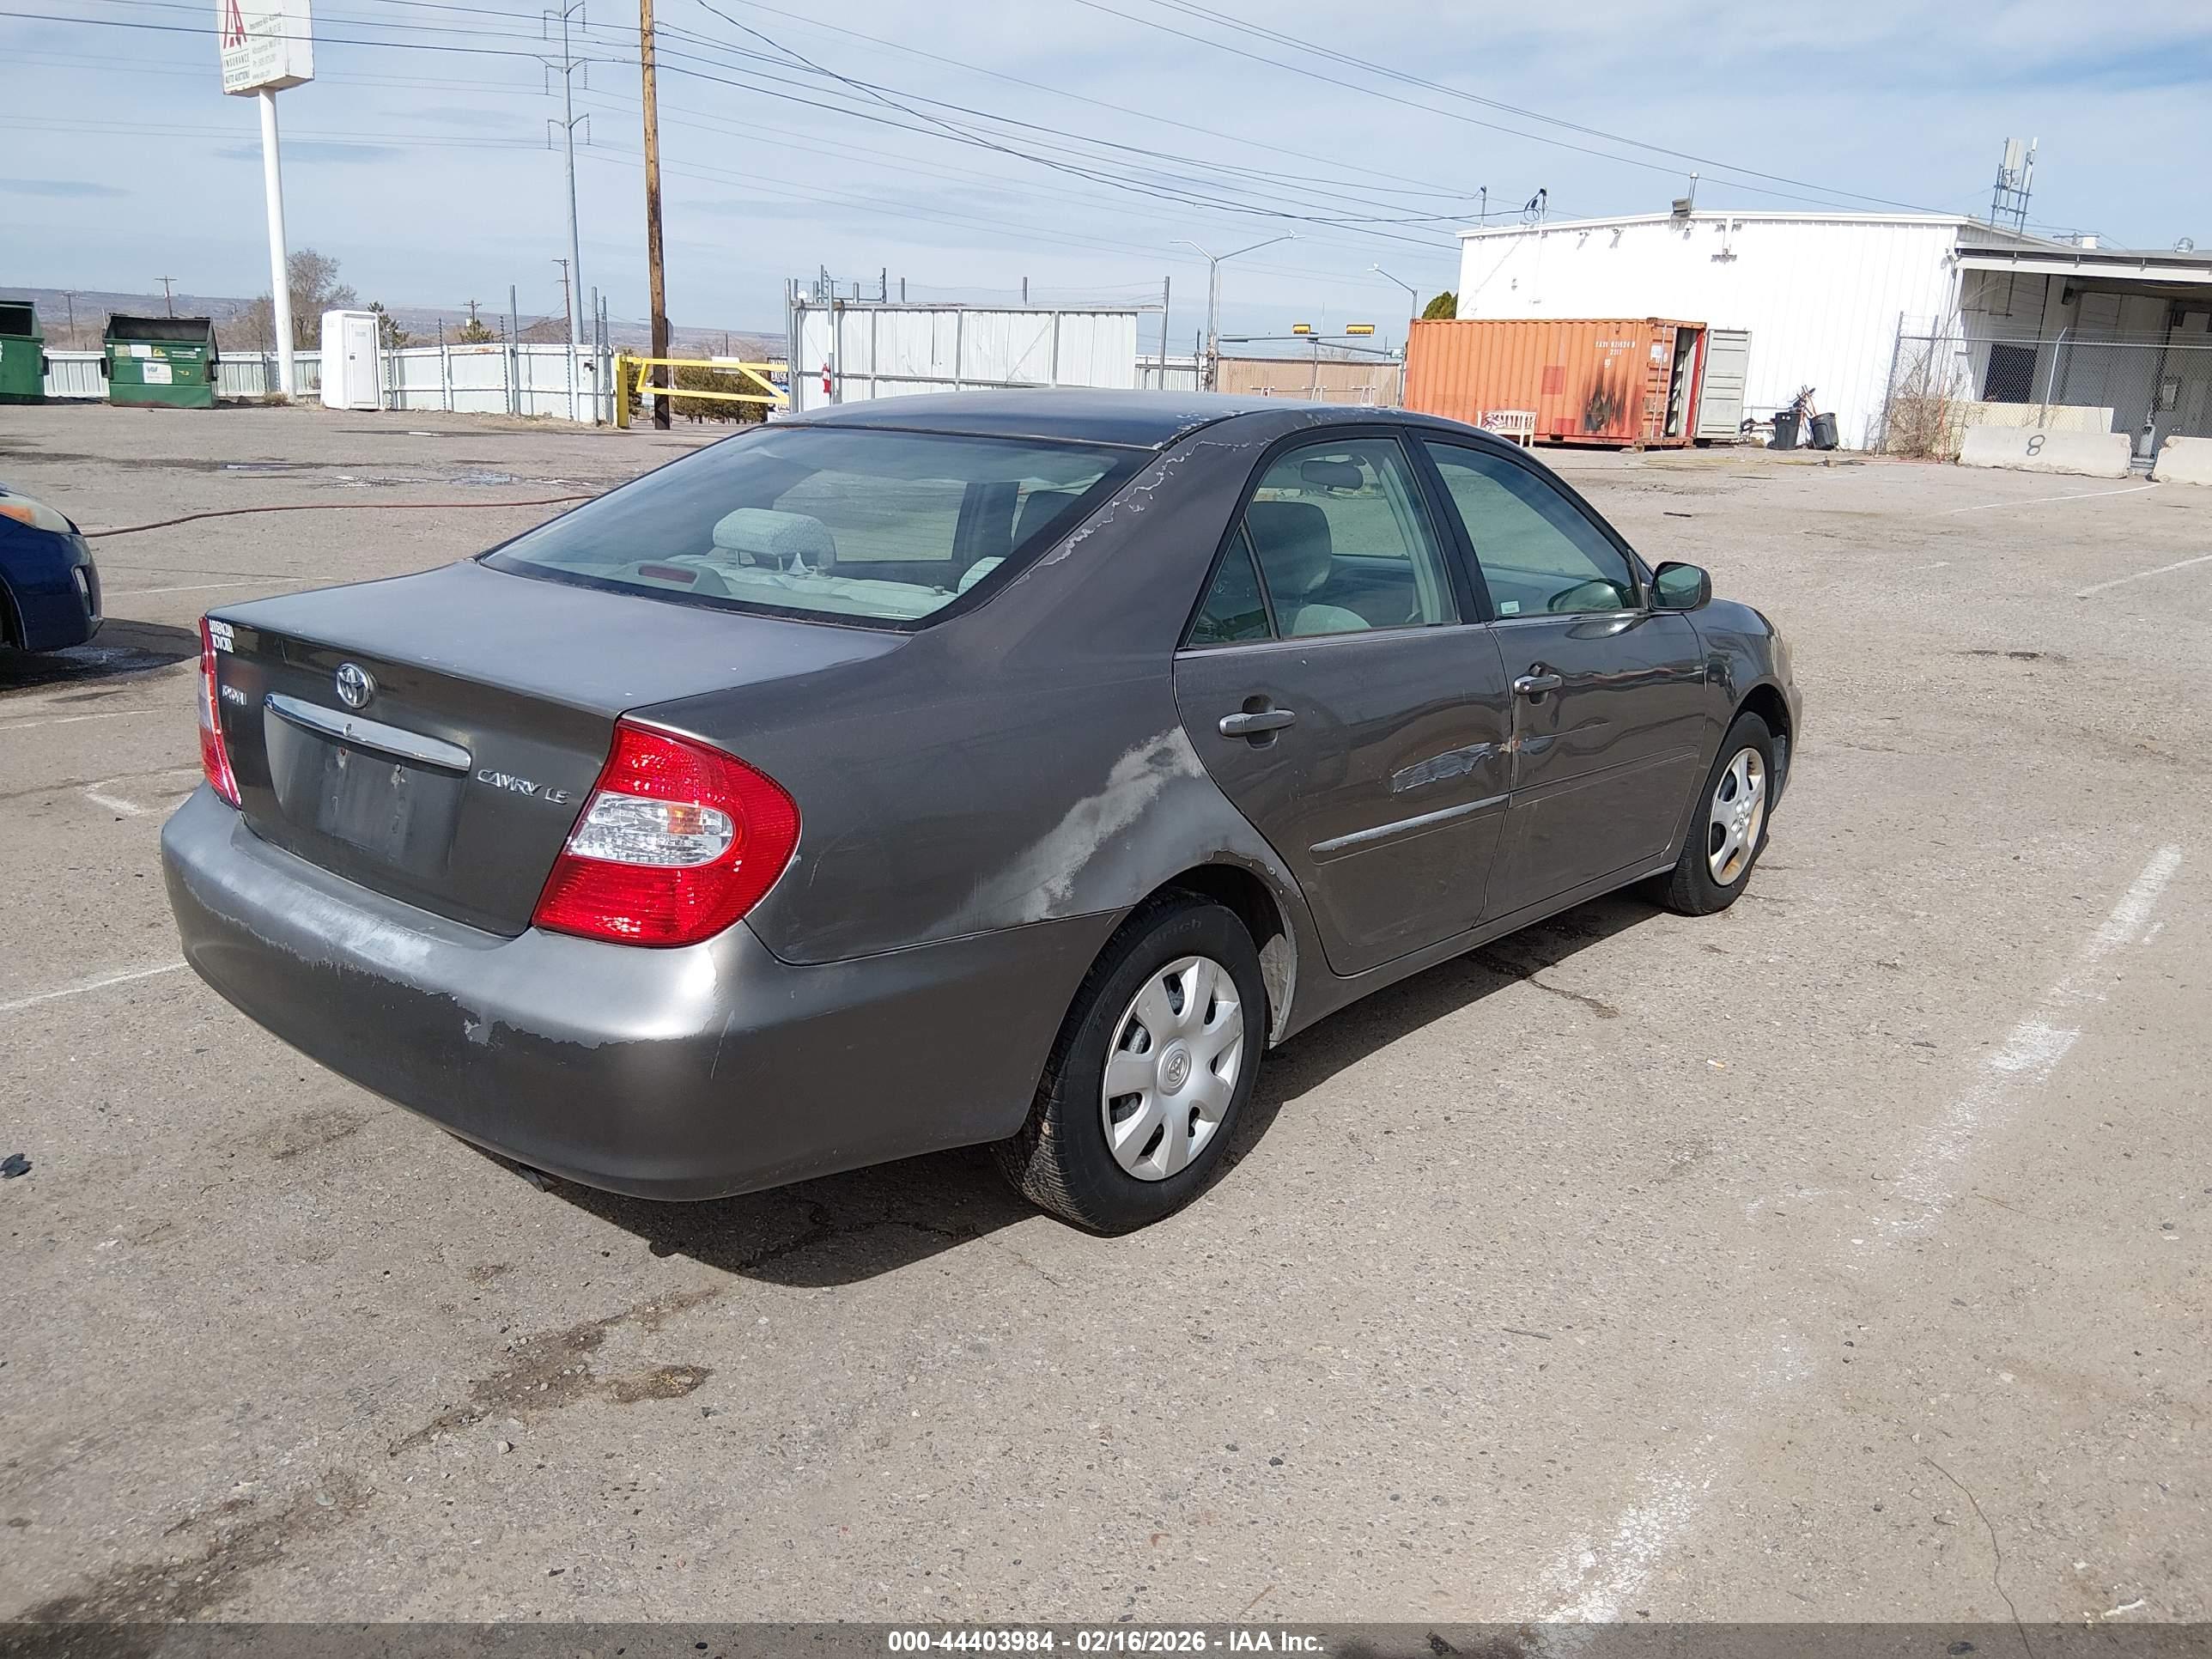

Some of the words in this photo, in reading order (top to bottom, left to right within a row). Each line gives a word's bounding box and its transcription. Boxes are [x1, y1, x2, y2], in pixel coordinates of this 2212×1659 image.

[2027, 434, 2045, 456] 8
[210, 633, 234, 653] TOYOTA
[477, 769, 543, 797] CAMRY
[544, 787, 570, 805] LE
